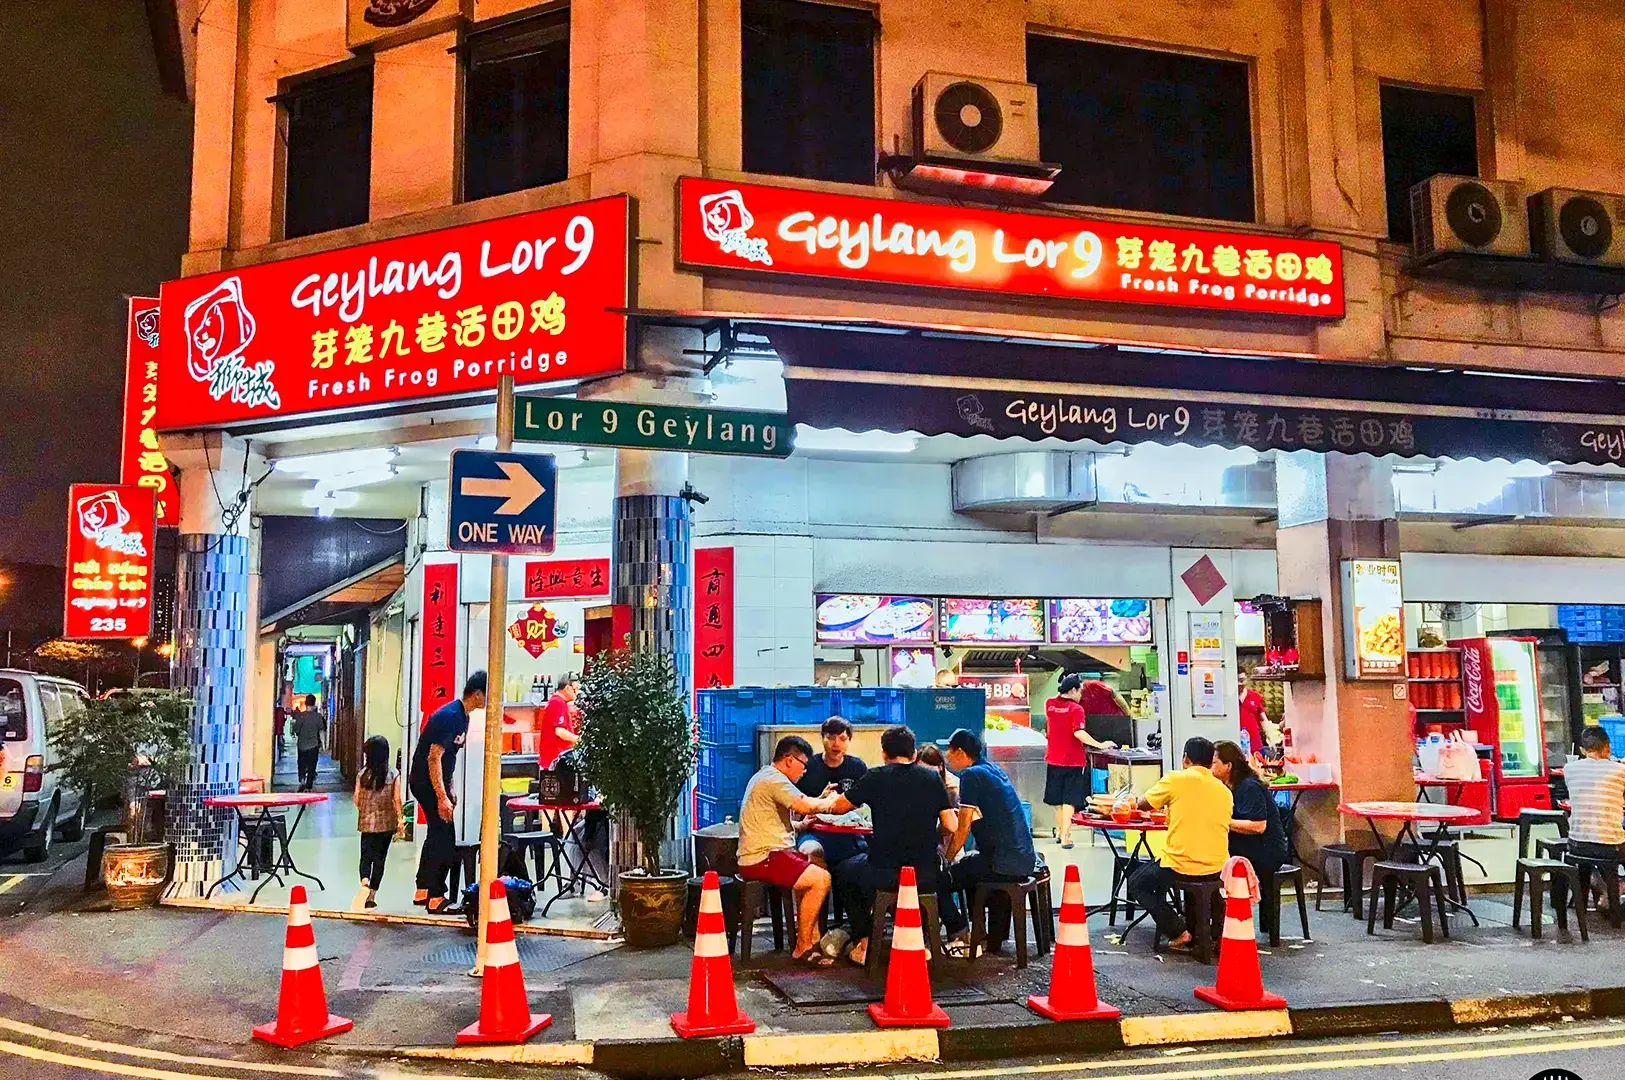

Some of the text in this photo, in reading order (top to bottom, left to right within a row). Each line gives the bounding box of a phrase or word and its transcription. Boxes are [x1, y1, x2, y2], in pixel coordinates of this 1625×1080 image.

[778, 211, 976, 273] Geylang
[290, 251, 463, 323] Geylang
[1121, 273, 1332, 307] Fresh Frog Porridge
[310, 291, 566, 369] 芽笼九巷活田鸡
[308, 348, 568, 399] Fresh Frog Porridge
[525, 402, 777, 451] Lor 9 Geylang
[1005, 398, 1117, 434] Geylang
[457, 521, 547, 545] ONE WAY
[90, 617, 127, 632] 235
[1463, 645, 1484, 713] Coca-Cola
[4, 775, 12, 784] 6
